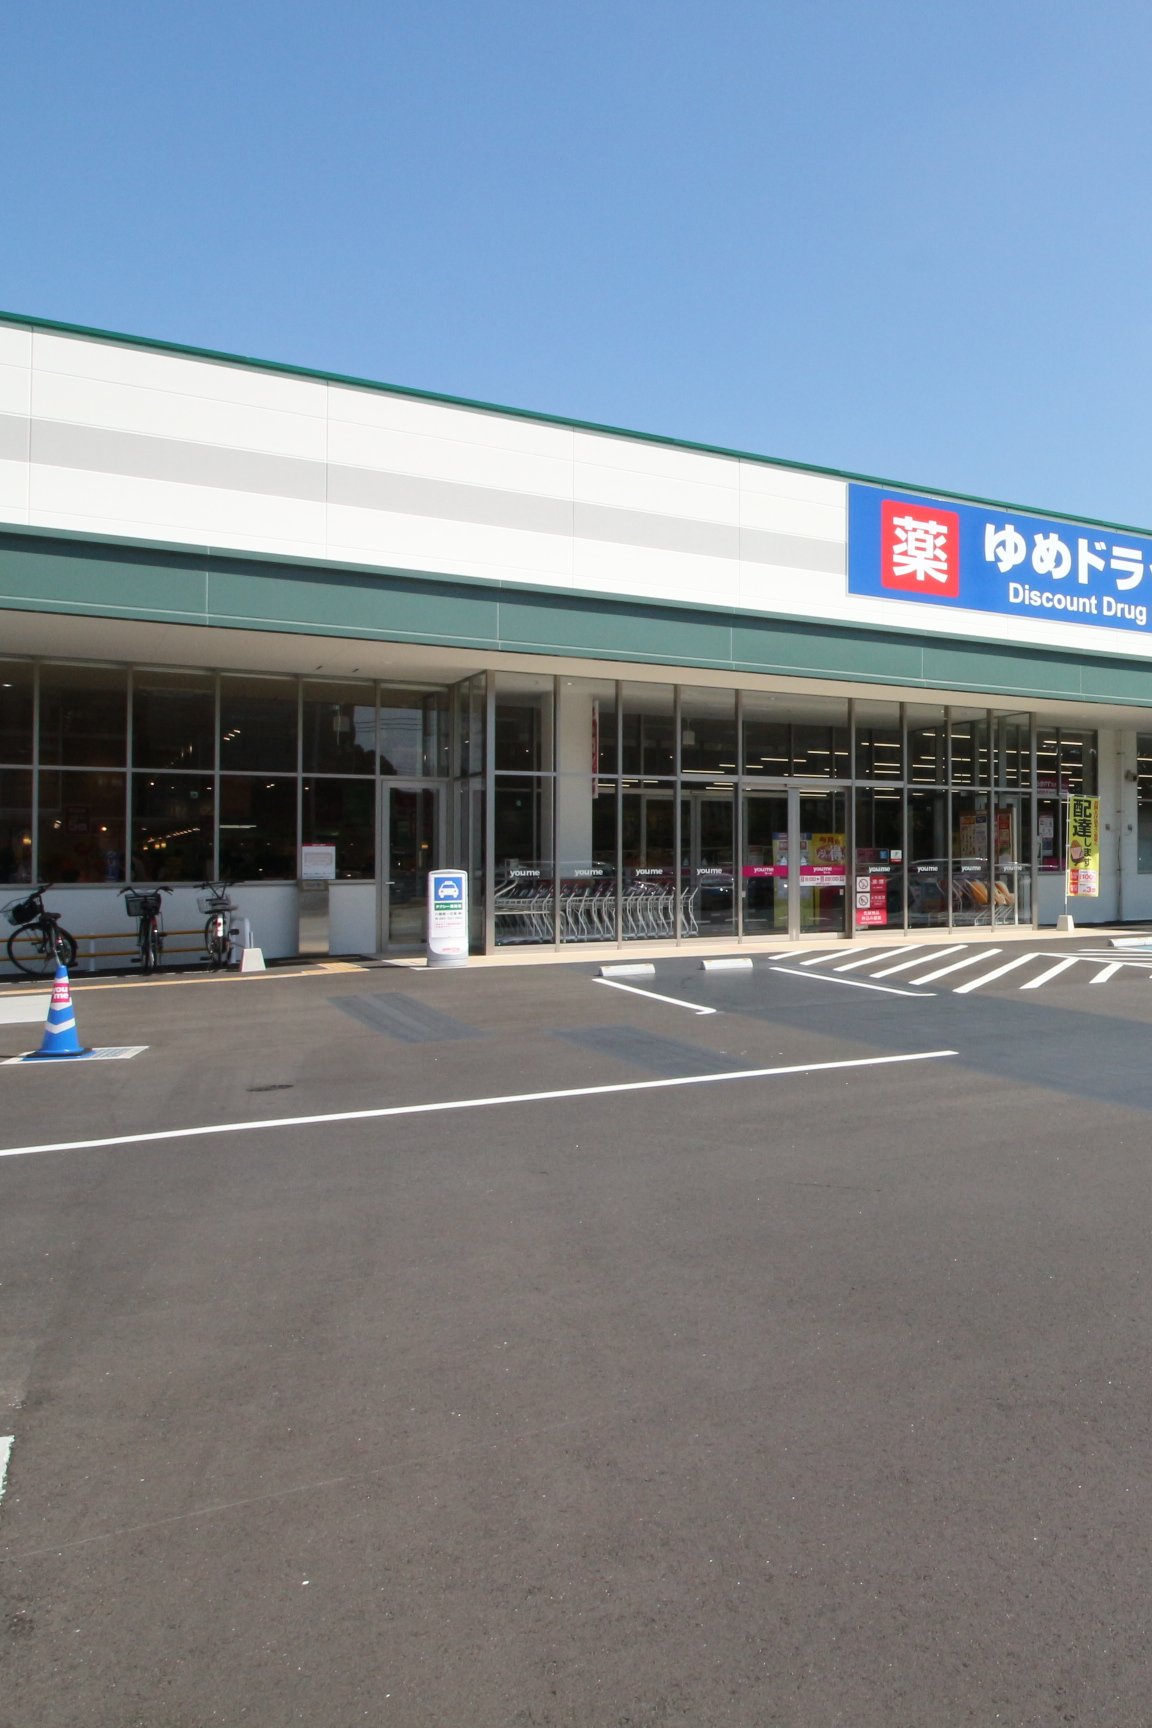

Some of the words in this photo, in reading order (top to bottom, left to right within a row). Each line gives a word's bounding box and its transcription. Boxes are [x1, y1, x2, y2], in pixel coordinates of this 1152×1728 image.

[892, 515, 949, 585] 薬
[1009, 582, 1098, 615] Discount
[1102, 596, 1147, 626] Drug
[1072, 798, 1093, 867] 配達します
[509, 867, 541, 878] youme
[574, 867, 604, 878] youme
[635, 866, 664, 877] youme
[696, 866, 723, 876] youme
[753, 866, 774, 874] youme
